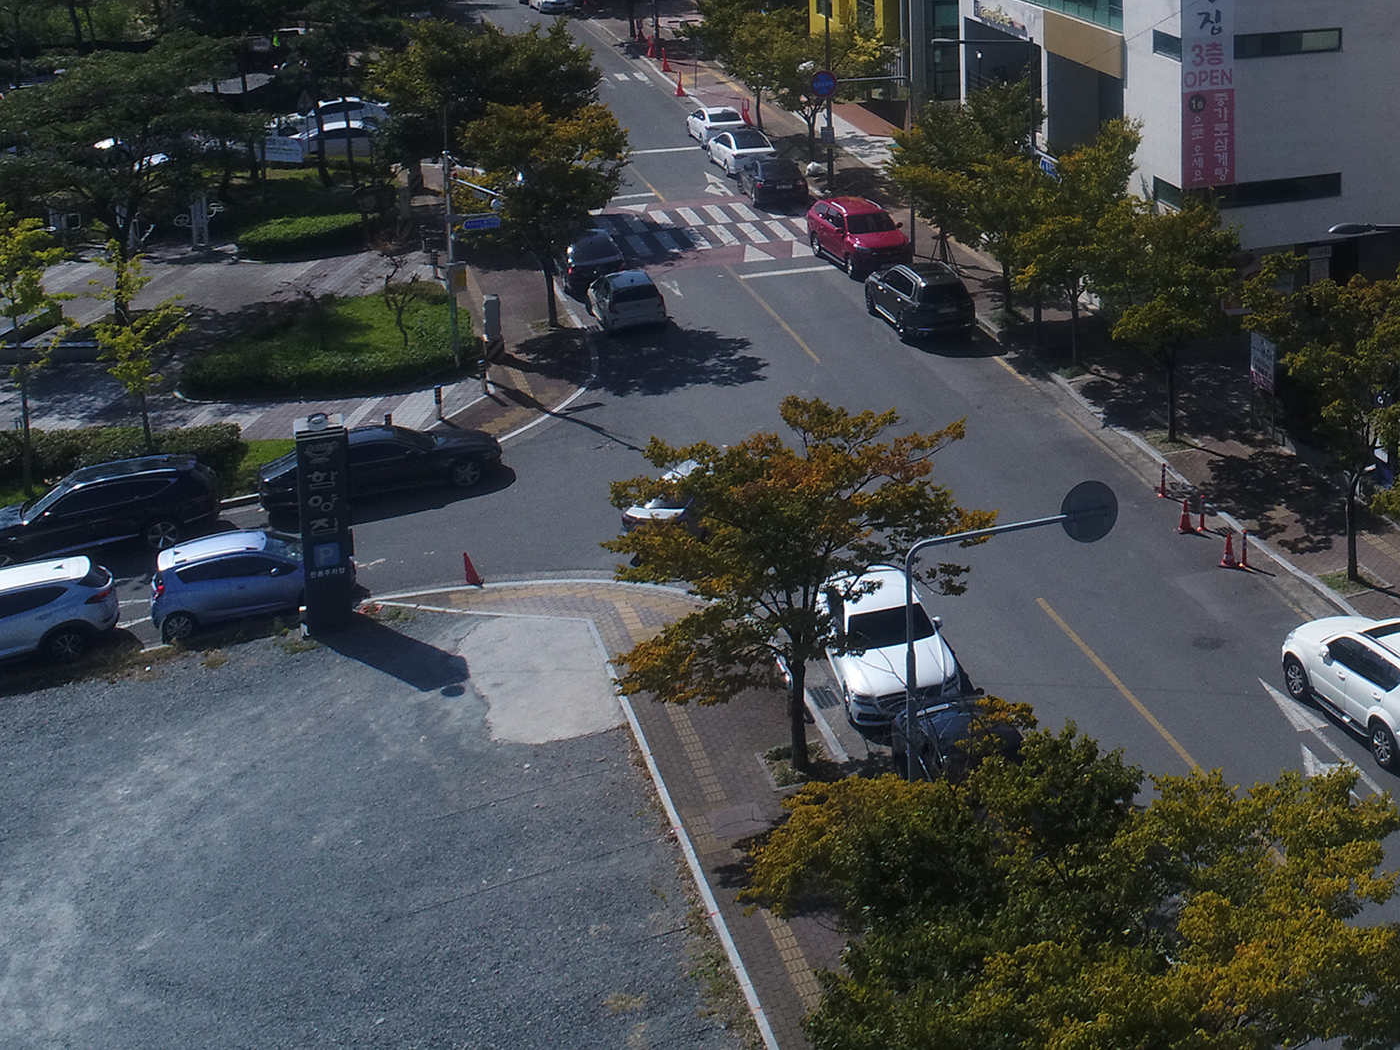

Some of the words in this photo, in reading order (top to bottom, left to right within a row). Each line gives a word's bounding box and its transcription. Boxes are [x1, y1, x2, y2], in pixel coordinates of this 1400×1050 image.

[1191, 41, 1225, 67] 3층
[1184, 68, 1233, 88] OPEN
[307, 471, 338, 537] 함양집
[319, 547, 334, 565] P
